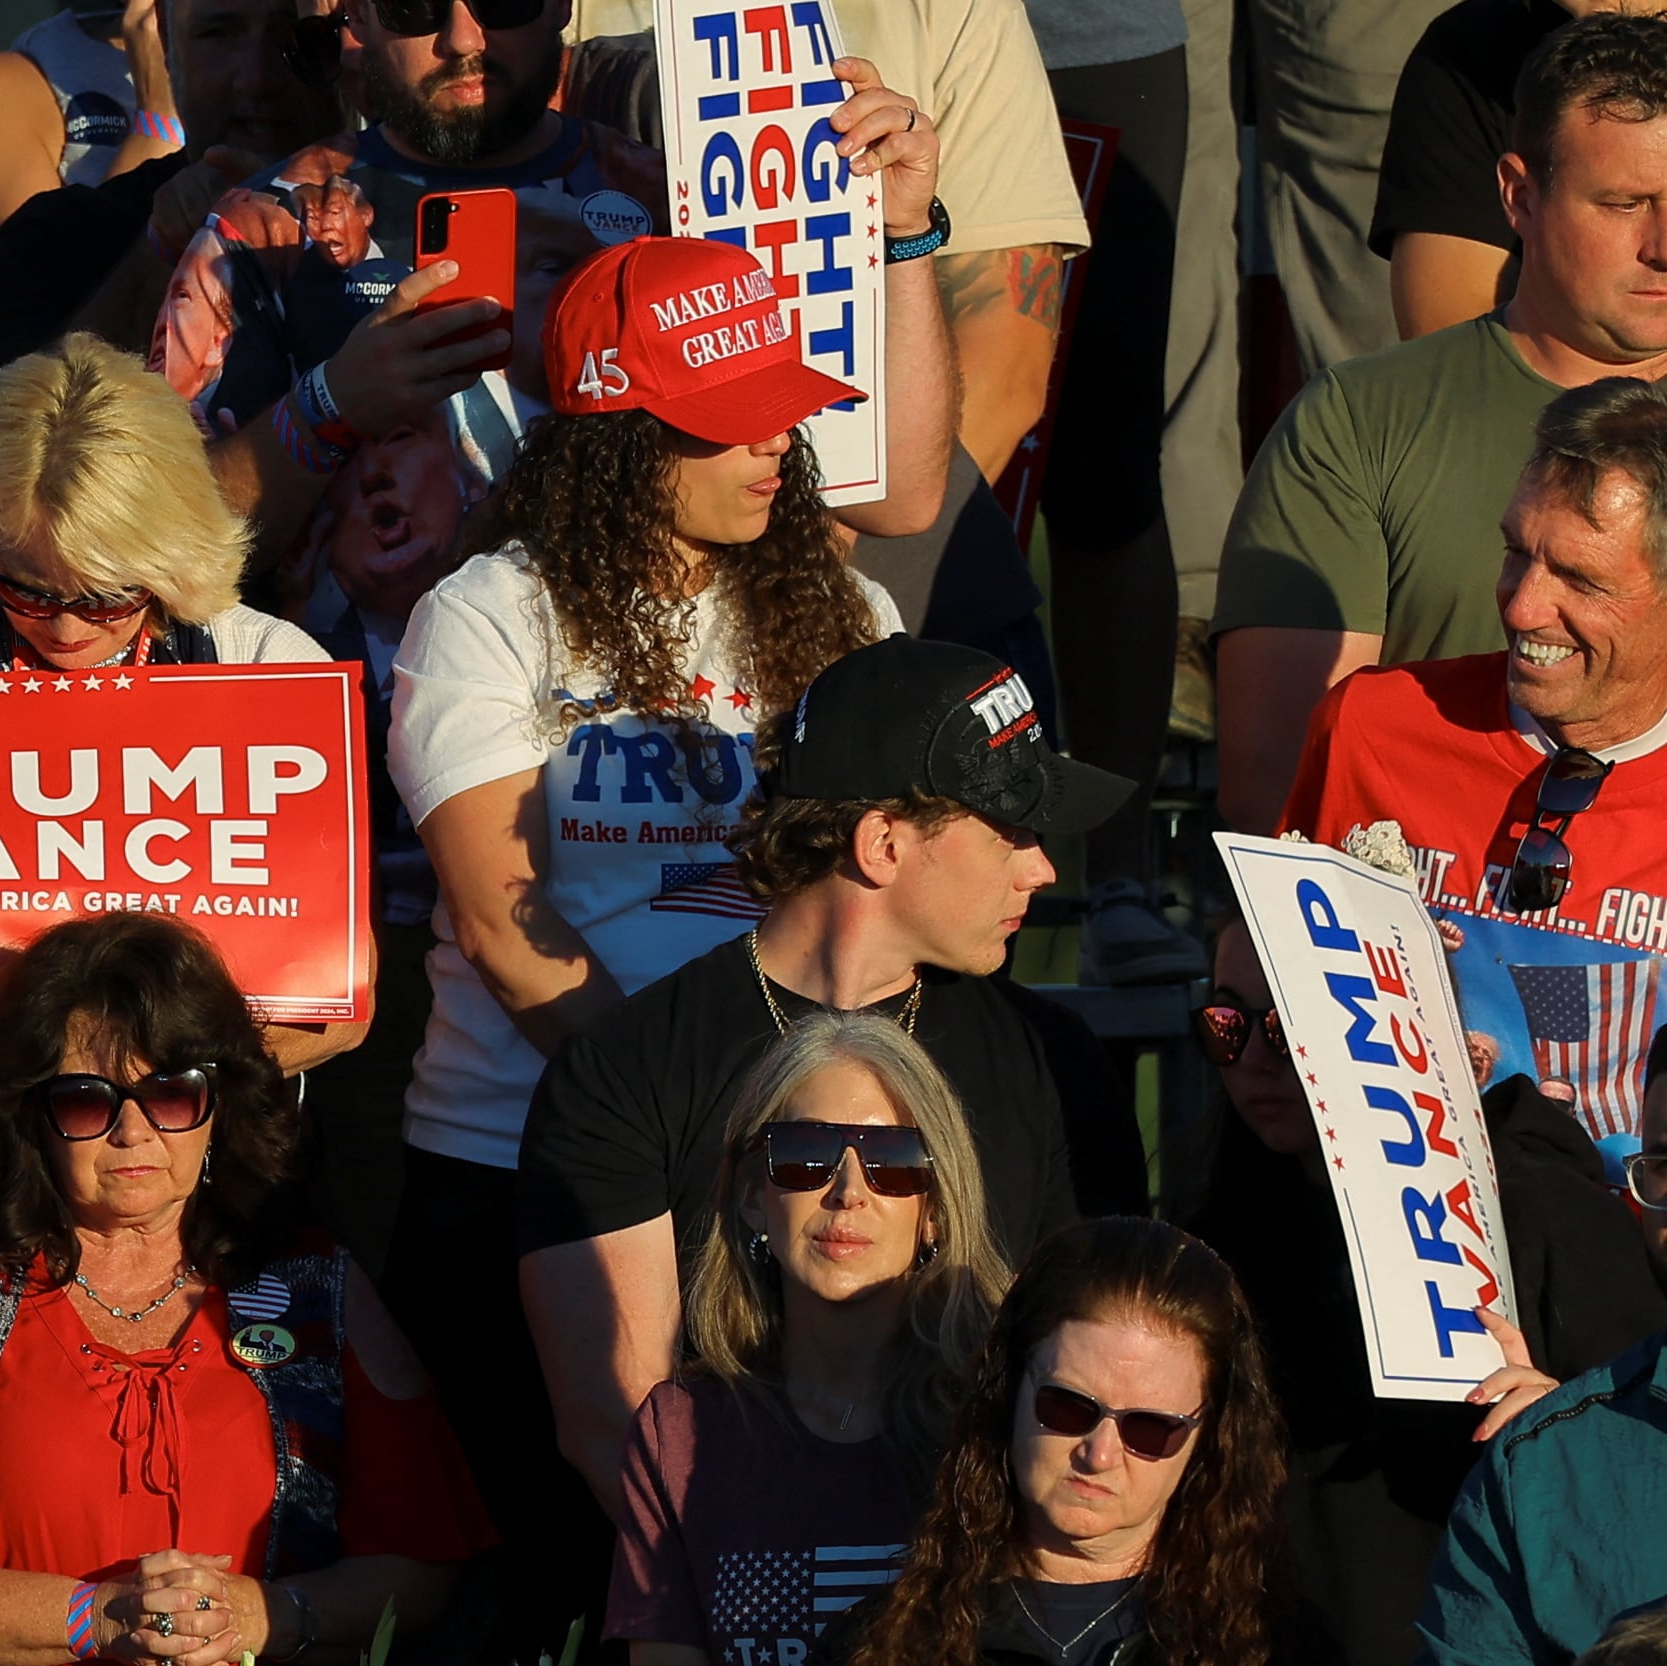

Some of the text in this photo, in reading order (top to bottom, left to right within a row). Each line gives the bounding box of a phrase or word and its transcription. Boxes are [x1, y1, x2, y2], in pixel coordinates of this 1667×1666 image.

[692, 12, 745, 247] FIG
[744, 5, 797, 358] FIGH
[676, 182, 690, 240] 20
[650, 288, 728, 333] MAKE
[681, 318, 746, 370] GREAT
[578, 348, 629, 399] 45
[970, 673, 1033, 735] TRU
[560, 818, 627, 842] Make
[82, 891, 183, 918] GREAT
[192, 893, 300, 920] AGAIN!
[1296, 877, 1487, 1359] TRUMP
[1376, 939, 1499, 1314] VANCE
[236, 1344, 285, 1360] TRUMP
